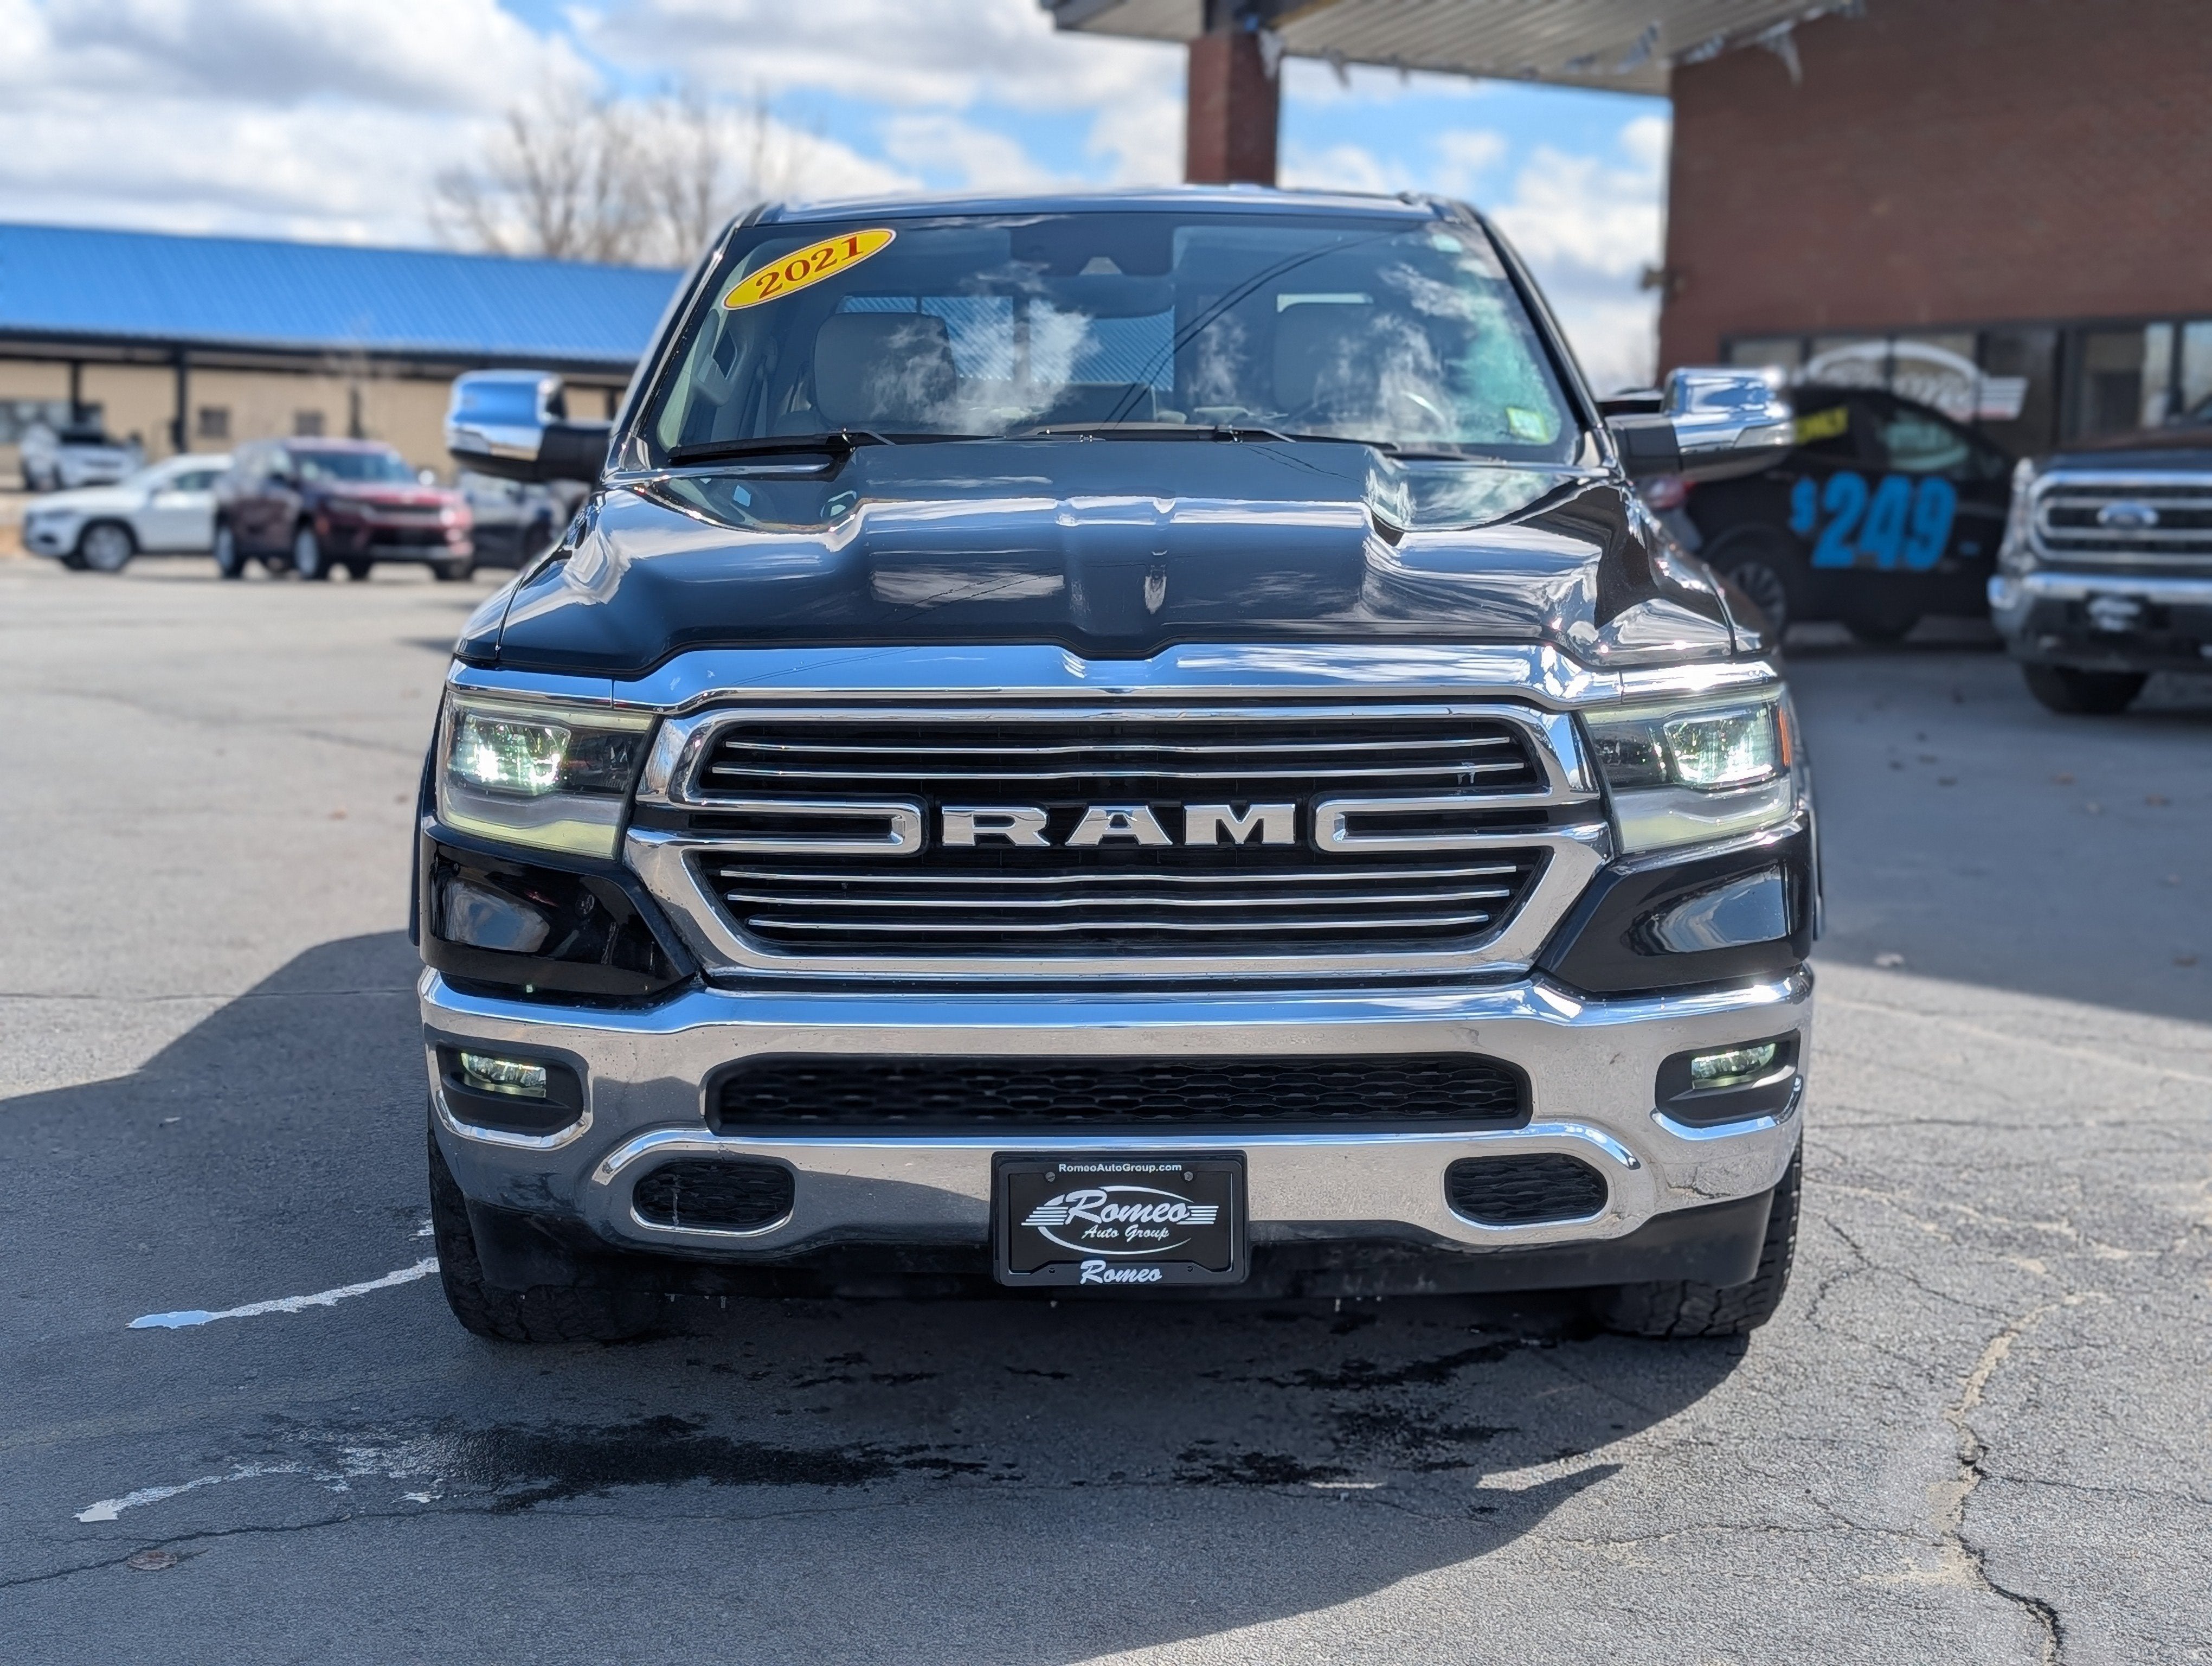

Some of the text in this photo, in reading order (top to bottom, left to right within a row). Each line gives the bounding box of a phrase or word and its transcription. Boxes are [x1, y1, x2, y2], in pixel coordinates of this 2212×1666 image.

[756, 236, 864, 299] 2021
[1789, 471, 1957, 571] $249
[942, 803, 1296, 847] RAM
[1059, 1163, 1182, 1173] RomeoAutoGroup.com
[1065, 1189, 1190, 1225] Romeo
[1081, 1223, 1169, 1242] Auto Group
[1080, 1259, 1163, 1284] Romeo
